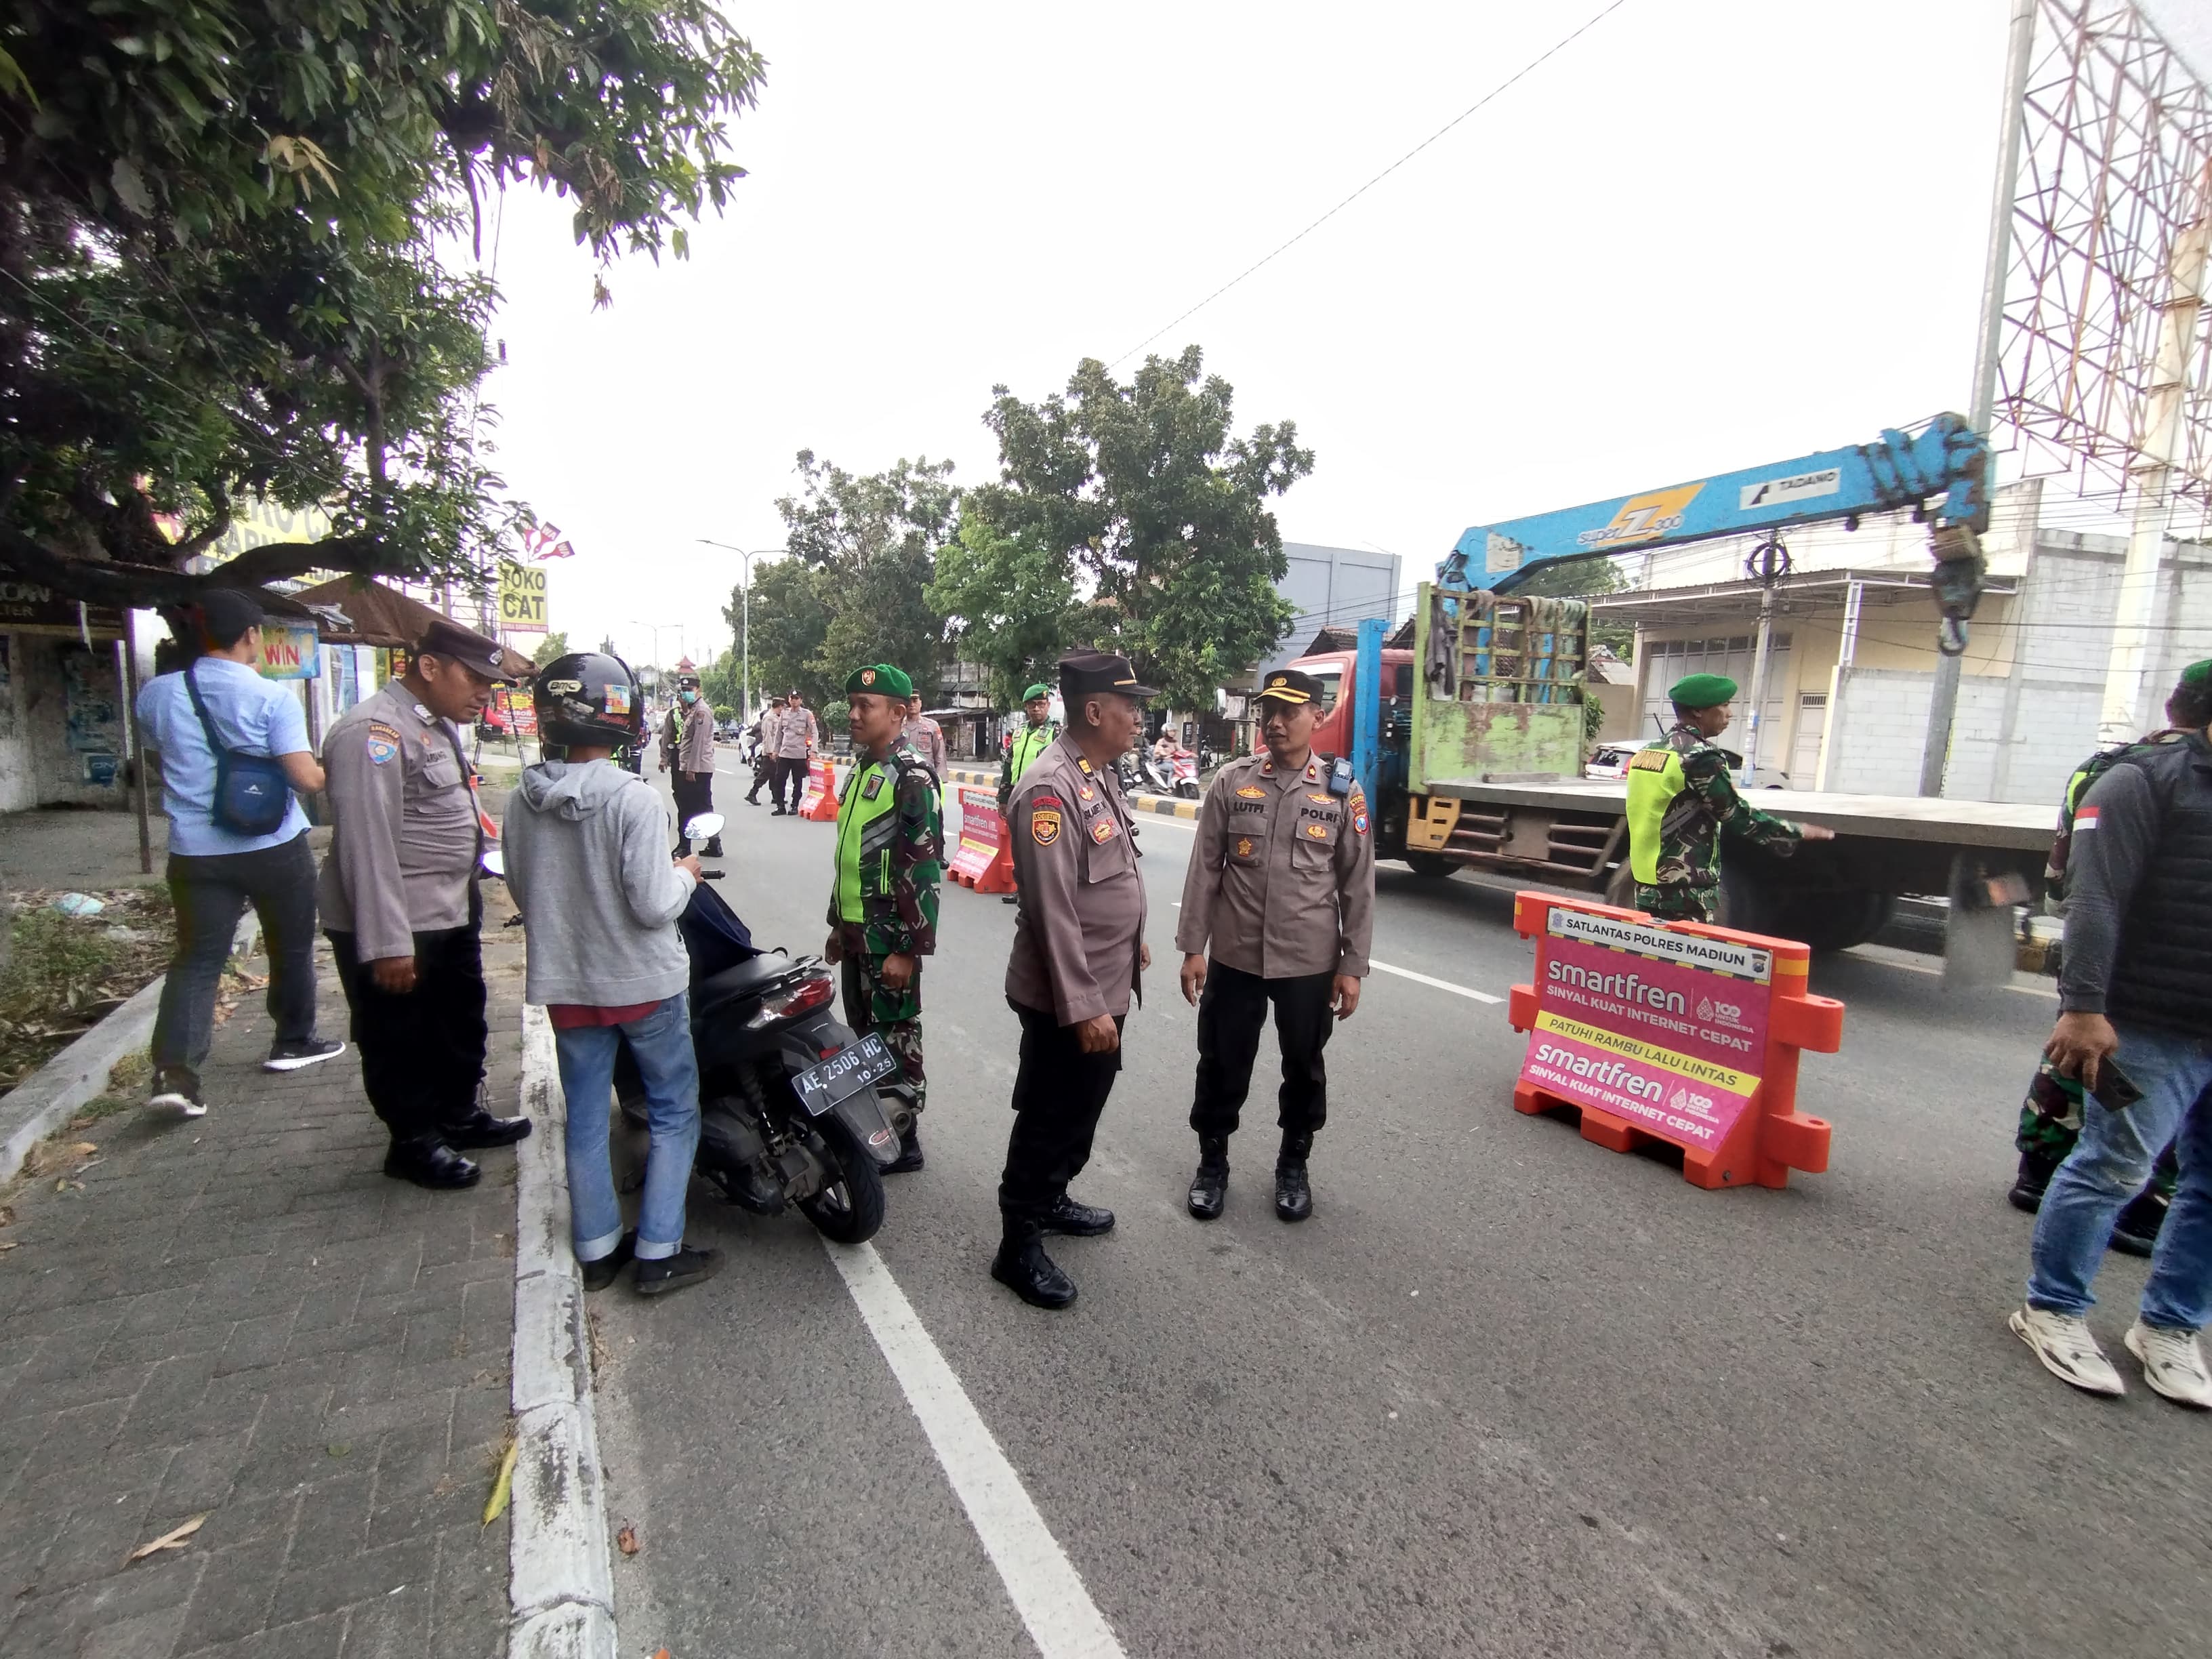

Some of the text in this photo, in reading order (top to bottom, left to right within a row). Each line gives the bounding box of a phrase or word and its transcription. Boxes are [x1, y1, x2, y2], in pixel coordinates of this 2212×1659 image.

[1779, 472, 1838, 491] TADANO
[1577, 527, 1620, 546] super
[1652, 514, 1683, 531] 300
[501, 569, 546, 591] TOKO
[503, 593, 544, 619] CAT
[550, 682, 577, 690] BMC
[1233, 802, 1265, 813] LUTFI
[1300, 807, 1336, 823] POLRI
[1566, 918, 1745, 966] SATLANTAS POLRES MADIUN
[1548, 960, 1685, 1016] smartfren
[1547, 985, 1753, 1052] SINYAL KUAT INTERNET CEPAT
[1715, 1012, 1740, 1024] UNTUK
[1715, 1019, 1754, 1033] INDONESIA
[1549, 1019, 1738, 1086] PATUHI RAMBU LALU LINTAS
[801, 1038, 881, 1094] AE 2506 HC
[1534, 1044, 1663, 1103] smartfren
[1529, 1064, 1715, 1139] SINYAL KUAT INTERNET CEPAT
[1687, 1103, 1709, 1114] UNTUK
